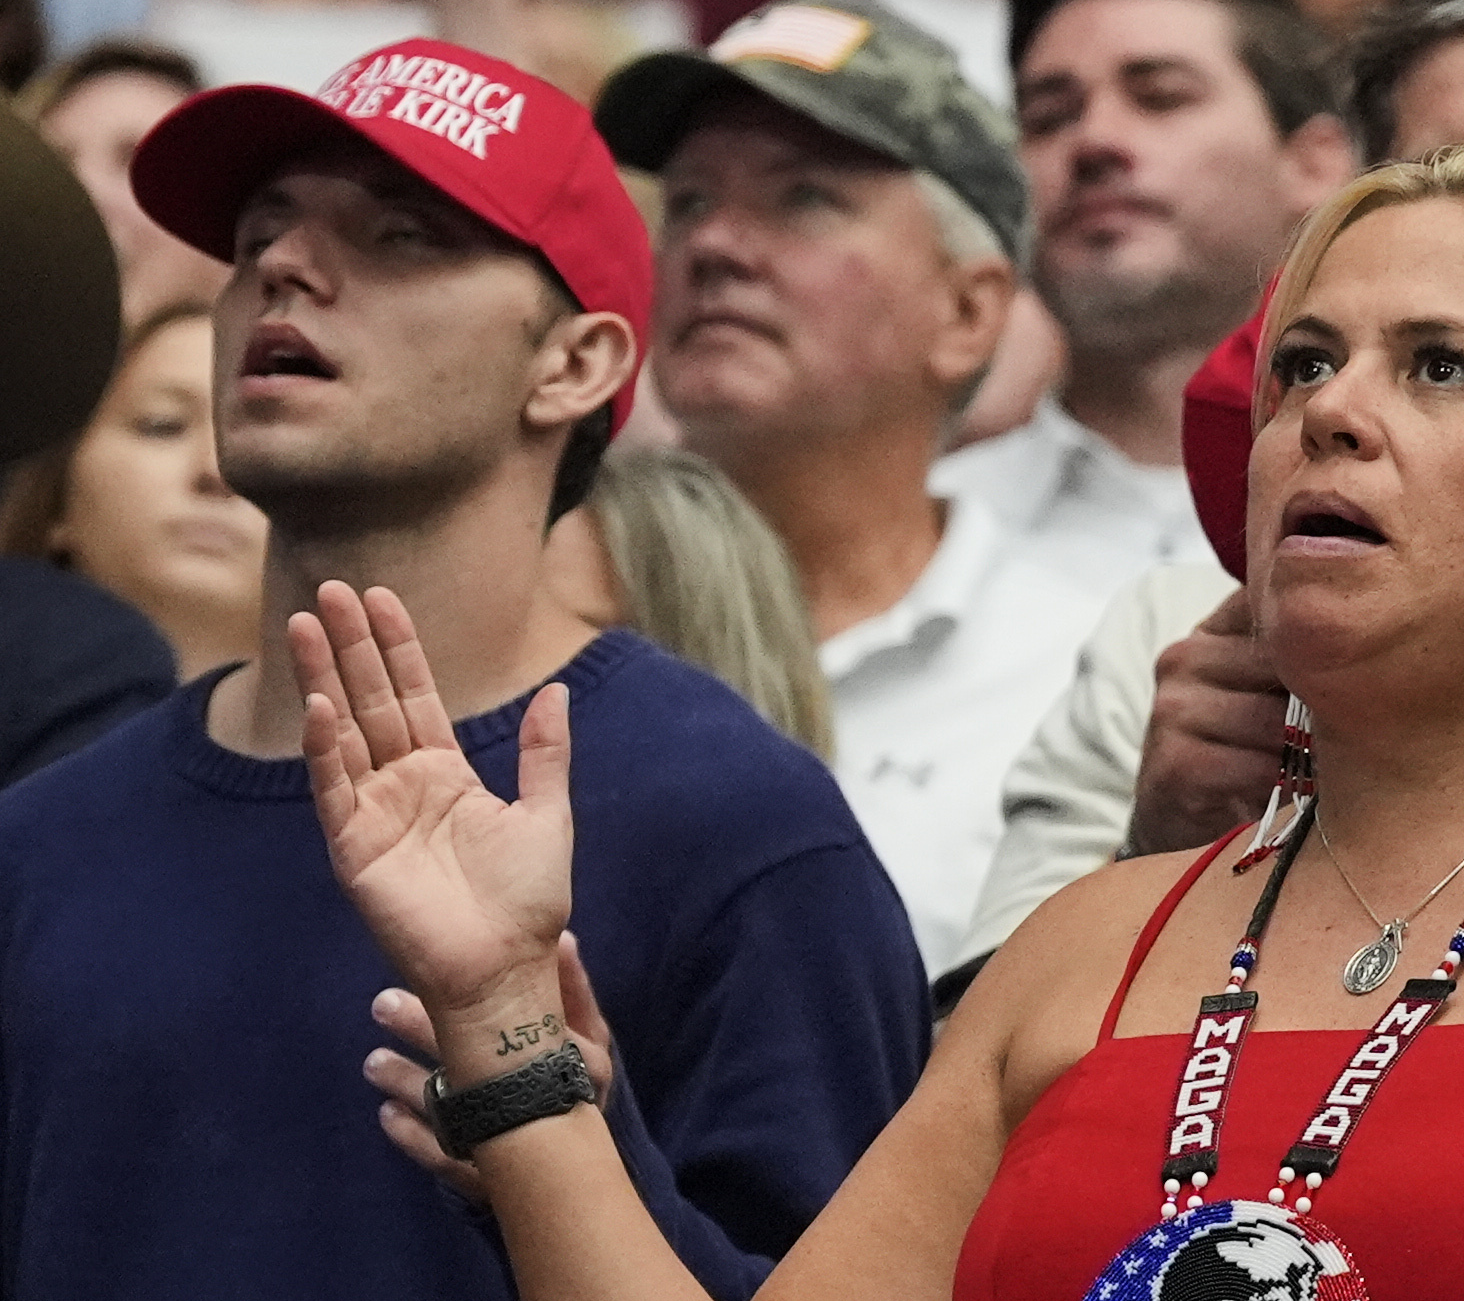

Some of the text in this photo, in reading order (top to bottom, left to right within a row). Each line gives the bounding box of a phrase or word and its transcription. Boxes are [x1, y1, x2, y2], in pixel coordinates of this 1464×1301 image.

[351, 53, 526, 135] AMERICA
[387, 88, 501, 161] KIRK
[1170, 1014, 1246, 1156] MAGA
[1302, 1000, 1433, 1145] MAGA
